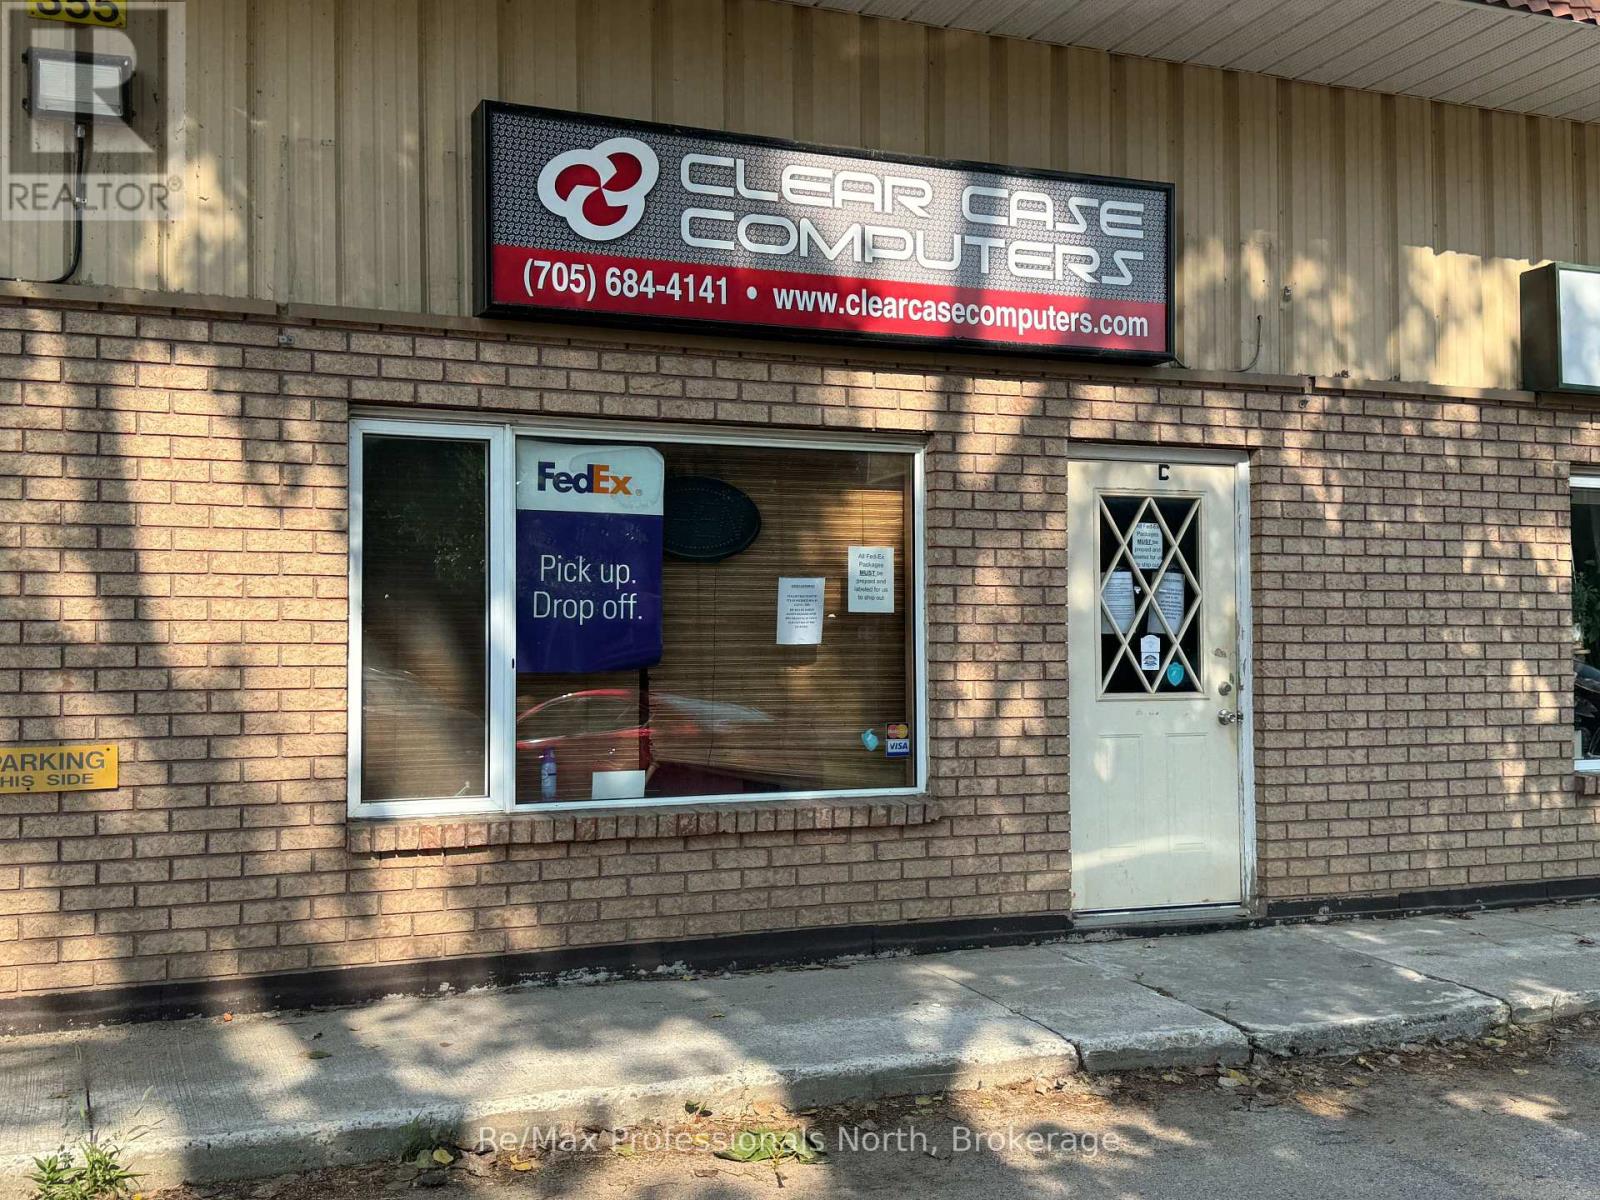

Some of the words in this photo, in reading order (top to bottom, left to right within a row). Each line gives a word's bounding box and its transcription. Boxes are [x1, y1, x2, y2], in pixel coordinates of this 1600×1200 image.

[680, 153, 932, 218] CLEAR
[961, 185, 1145, 239] CASE
[680, 208, 1144, 286] COMPUTERS
[524, 258, 596, 301] (705)
[605, 266, 728, 305] 684-4141
[773, 287, 1148, 337] www.clearcasecomputers.com
[1158, 464, 1170, 481] C
[540, 554, 592, 583] Pick
[600, 563, 636, 590] up.
[533, 591, 594, 626] Drop
[602, 592, 643, 620] off.
[0, 751, 105, 772] ARKING
[46, 773, 95, 786] SIDE
